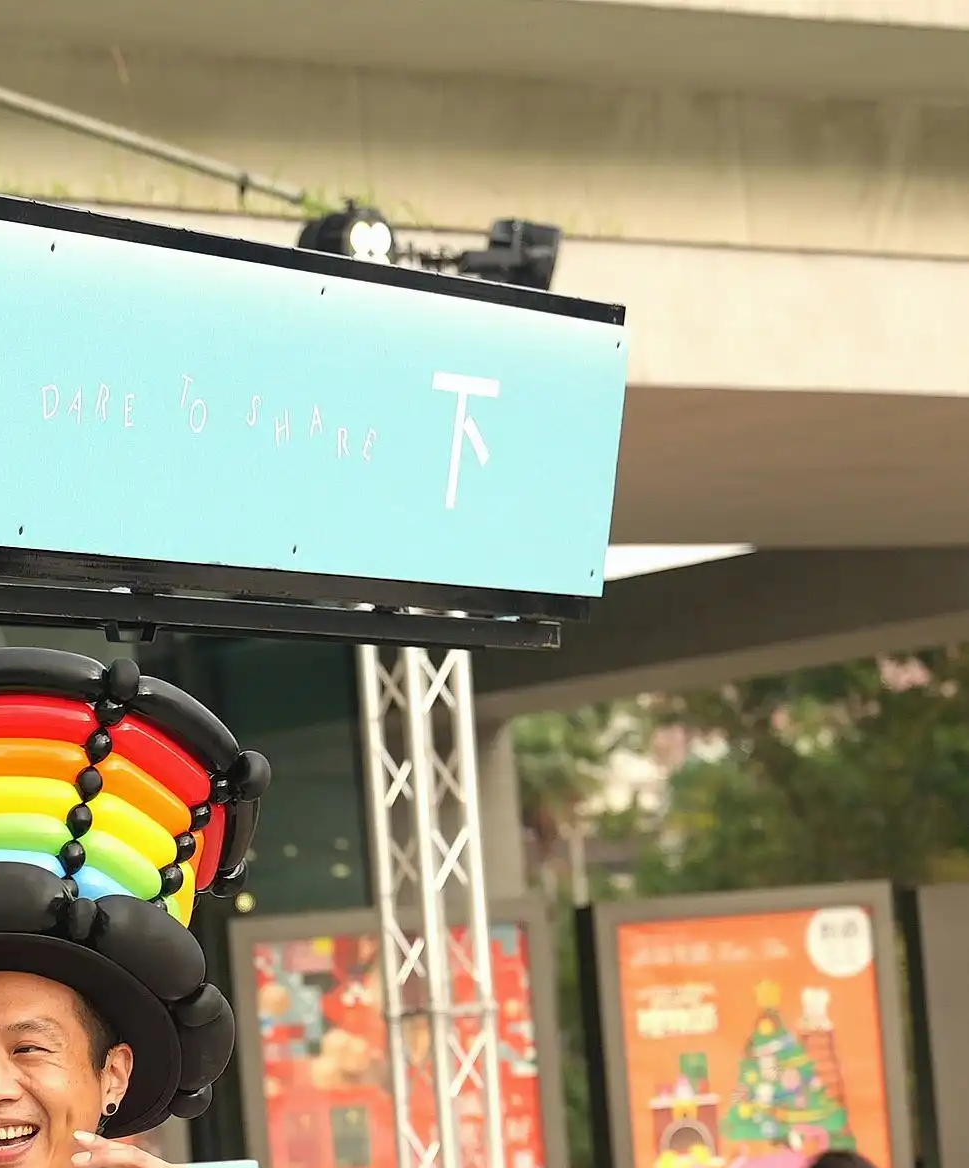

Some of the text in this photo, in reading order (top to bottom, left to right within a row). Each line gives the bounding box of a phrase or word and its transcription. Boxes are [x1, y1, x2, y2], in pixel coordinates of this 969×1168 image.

[41, 373, 377, 461] DARE TO SHARE
[431, 371, 500, 509] 下
